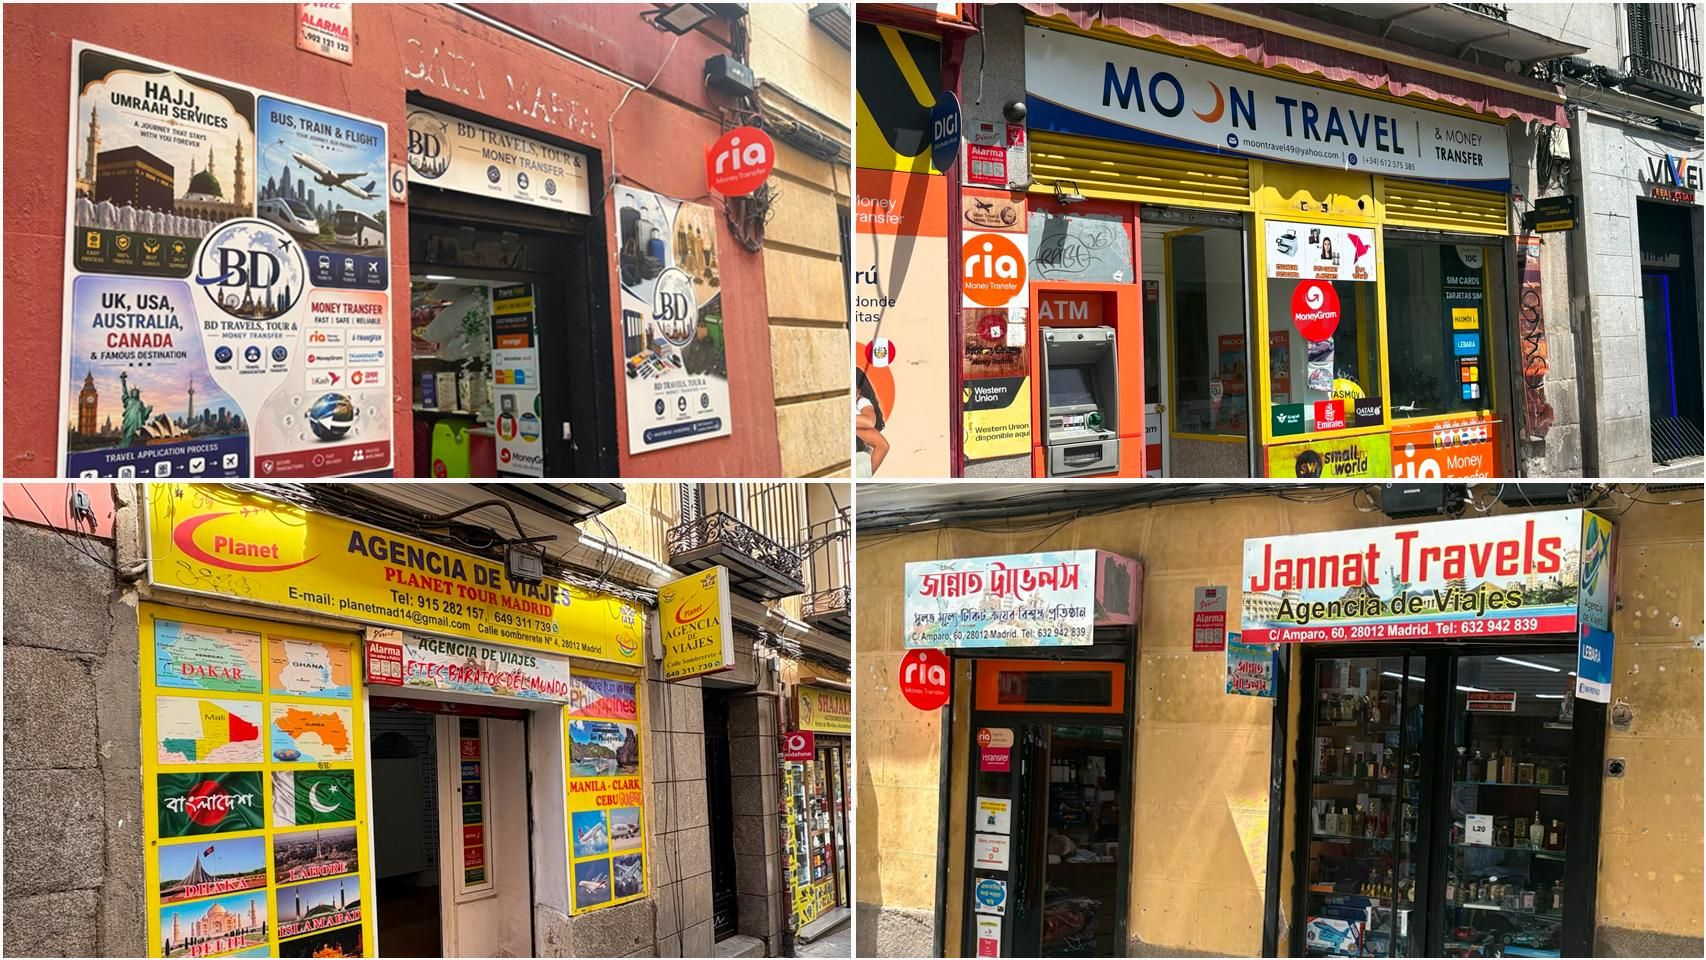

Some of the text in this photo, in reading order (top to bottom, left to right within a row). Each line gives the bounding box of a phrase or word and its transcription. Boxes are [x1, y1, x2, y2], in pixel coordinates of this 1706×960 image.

[302, 13, 349, 37] ALARMA
[322, 38, 349, 52] 121 122
[145, 81, 199, 112] HAJJ,
[111, 92, 228, 129] UMRAAH SERVICES
[141, 122, 170, 134] JOURNEY
[172, 129, 188, 137] THAT
[189, 132, 207, 141] STAYS
[270, 111, 378, 147] BUS, TRAIN FLIGHT
[934, 112, 957, 142] DIGI
[1276, 95, 1405, 155] TRAVEL
[140, 131, 200, 148] WITH YOU FOREVER
[457, 123, 582, 168] BD TRAVELS, TOUR &
[1435, 128, 1482, 147] & MONEY
[716, 137, 766, 174] ria
[972, 146, 1004, 158] Alarma
[1243, 138, 1339, 160] moontravel49@yahoo.com
[1435, 146, 1483, 167] TRANSFER
[482, 148, 565, 177] MONEY TRANSFER
[1363, 156, 1415, 171] (+34) 612 575 385
[392, 170, 404, 193] 6
[1655, 188, 1671, 197] REAL
[217, 247, 281, 288] BD
[965, 242, 1018, 279] ria
[965, 281, 1017, 291] Money Transfer
[1446, 276, 1480, 285] SIM CARDS
[102, 293, 175, 313] UK, USA,
[1446, 292, 1482, 300] TARJETAS SIM
[311, 302, 383, 314] MONEY TRANSFER
[660, 292, 688, 320] BD
[1038, 300, 1088, 320] ATM
[92, 314, 184, 331] AUSTRALIA,
[1295, 311, 1336, 321] MoneyGram
[204, 320, 219, 330] BD
[221, 321, 265, 332] TRAVELS,
[267, 322, 289, 330] TOUR
[107, 332, 173, 348] CANADA
[309, 331, 325, 342] ria
[90, 350, 187, 360] & FAMOUS DESTINATION
[974, 386, 1007, 396] Western
[975, 394, 999, 403] Union
[1356, 406, 1374, 414] QATAR
[975, 423, 1029, 434] Western Union
[1317, 421, 1344, 430] Emirates
[975, 433, 1013, 442] disponible
[105, 443, 218, 463] TRAVEL APPLICATION PROCESS
[1325, 445, 1358, 464] small
[1447, 455, 1483, 470] Money
[1335, 457, 1368, 475] world
[214, 536, 279, 559] Planet
[1251, 520, 1562, 593] Jannat Travels
[348, 530, 501, 590] AGENCIA DE
[919, 562, 1080, 600] জান্নাত ট্রাভেলস
[384, 566, 553, 617] PLANET TOUR MADRID
[390, 589, 551, 632] Tel: 915 282 649 311 739
[1276, 586, 1522, 625] Agencia de Viajes
[288, 586, 602, 655] E-mail: planetmad14@gmail.com Calle sombrerete 28012 Madrid
[665, 616, 720, 640] AGENCIA
[1196, 614, 1223, 623] Alarma
[687, 632, 696, 640] DE
[911, 627, 1086, 641] C/ 60, 28012 Madrid. Tel: 632 942 839
[1282, 618, 1538, 642] Amparo, 60, 28012 Madrid. Tel: 632 942 839
[370, 643, 401, 656] Alarma
[481, 648, 496, 661] DE
[672, 636, 714, 654] VIAJES
[292, 662, 324, 670] GHANA
[666, 653, 717, 668] Calle Sombrerete
[666, 662, 713, 678] 649 311 739
[905, 652, 946, 687] ria
[181, 662, 241, 679] DAKAR
[448, 662, 569, 697] BARATOS DEL MUNDO
[979, 730, 990, 741] ria
[570, 779, 640, 793] MANILA CLARK
[164, 793, 254, 813] বাংলাদেশ
[596, 796, 619, 806] CEBU
[289, 862, 348, 881] LAHORE
[184, 877, 249, 898] DHAKA
[278, 909, 361, 936] ISLAMABAD
[191, 936, 247, 957] DELHI
